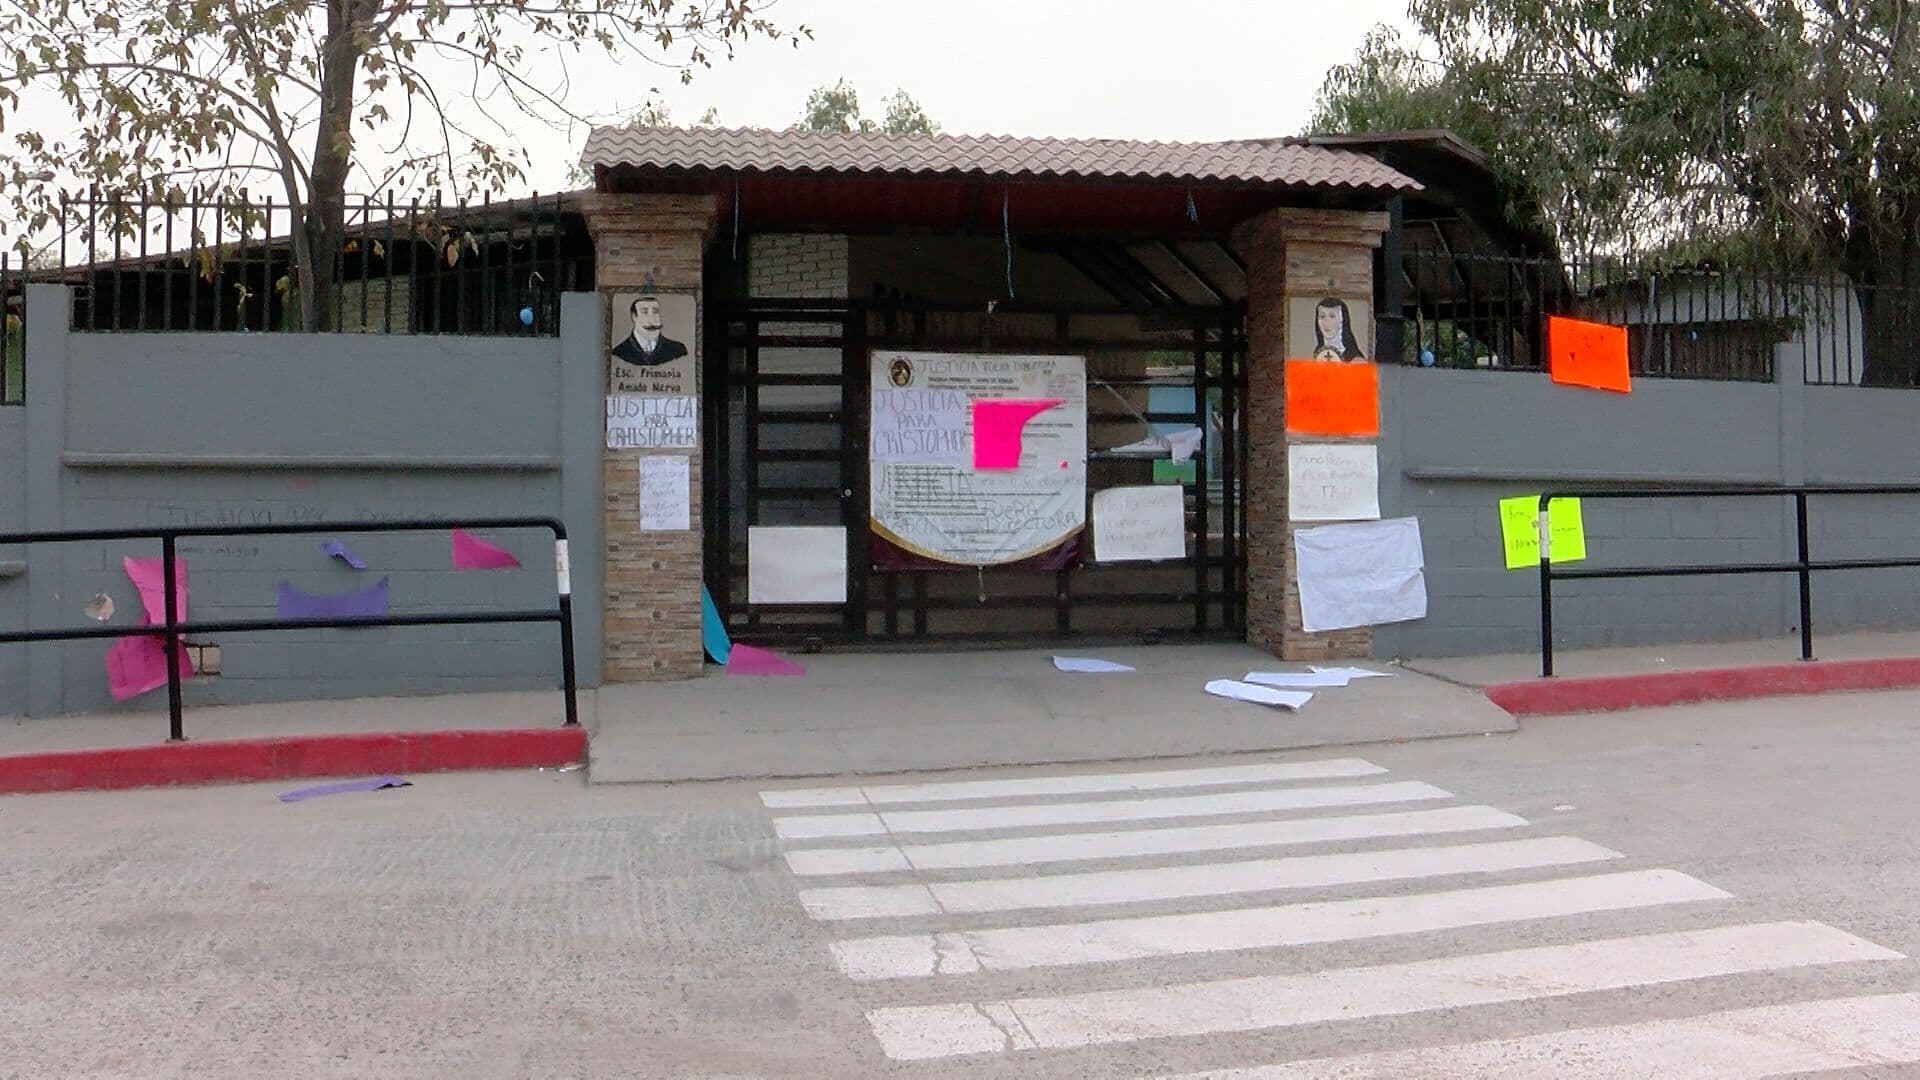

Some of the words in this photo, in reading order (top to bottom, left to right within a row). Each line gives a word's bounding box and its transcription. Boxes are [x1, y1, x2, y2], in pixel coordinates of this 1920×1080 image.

[615, 367, 635, 378] Esc.
[640, 367, 682, 378] Primaria
[653, 382, 681, 392] Nervo
[607, 395, 693, 418] JUSTICIA
[874, 390, 962, 413] JUSTICIA
[642, 416, 669, 428] PARA
[896, 411, 938, 430] PARA
